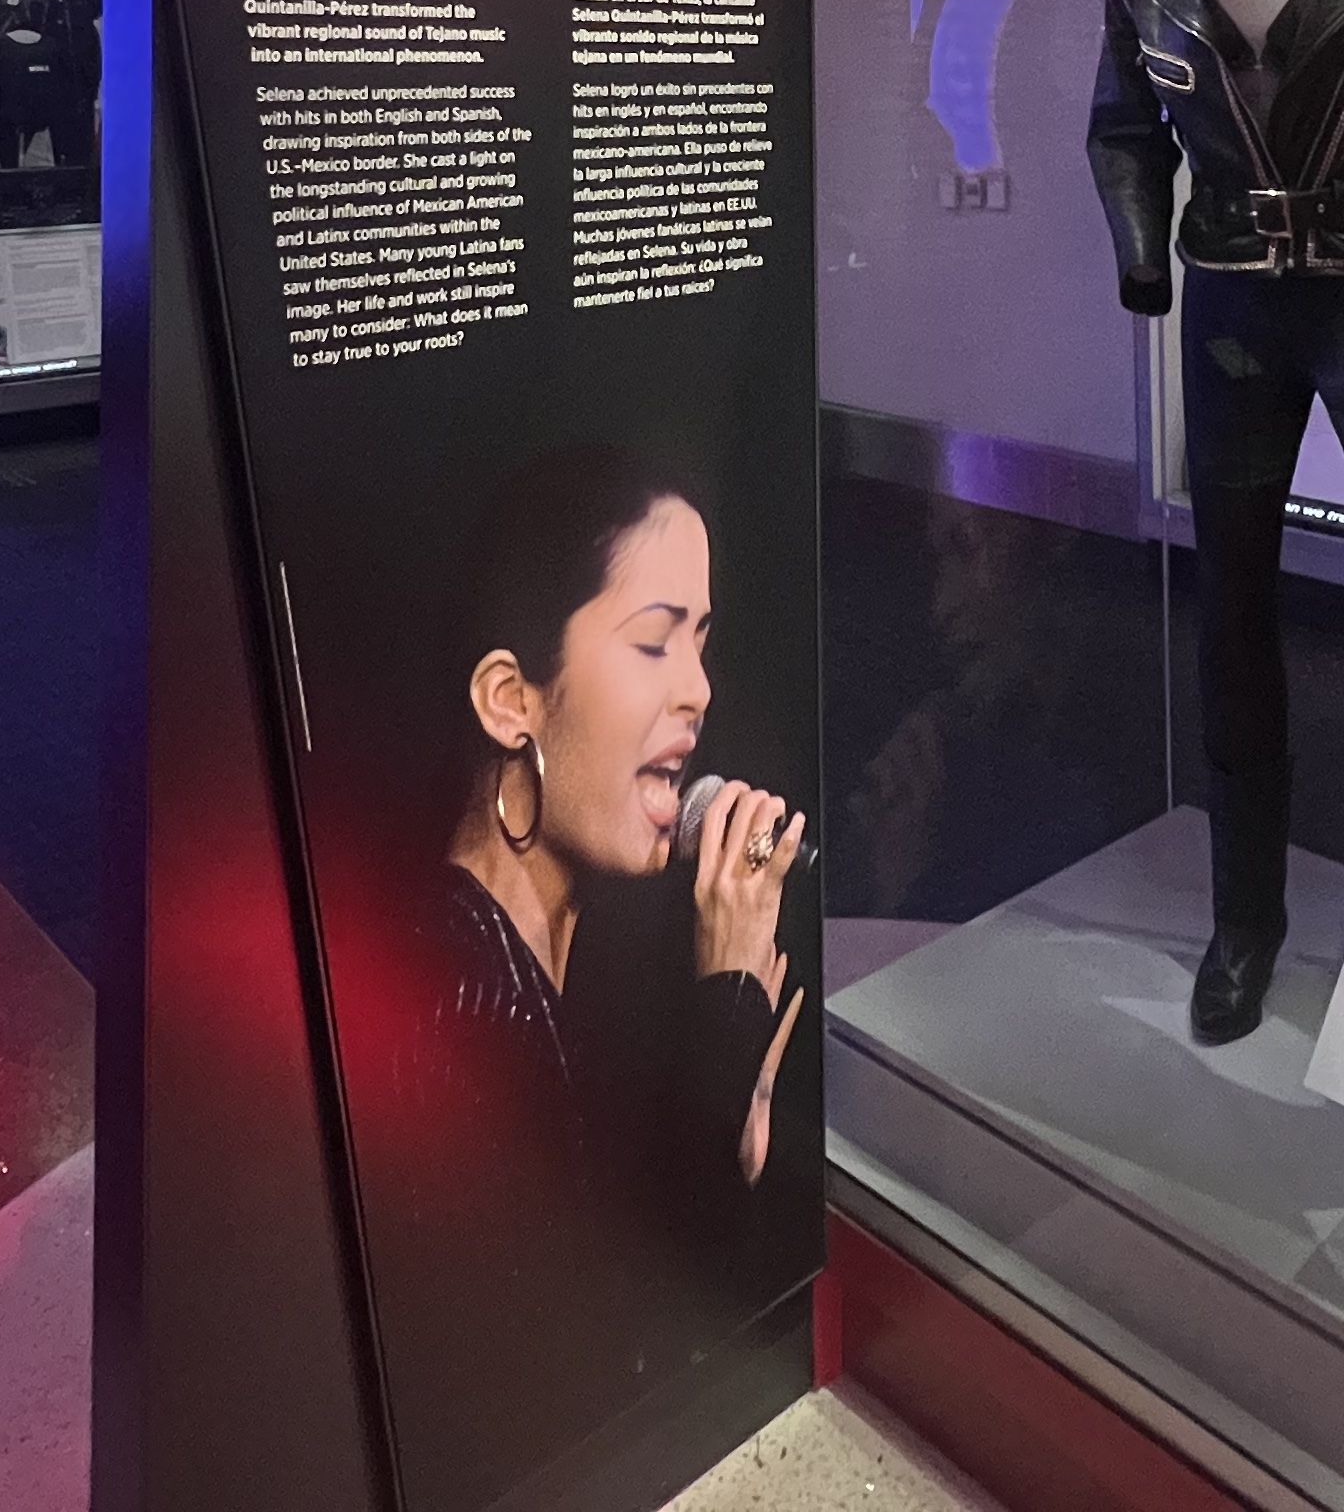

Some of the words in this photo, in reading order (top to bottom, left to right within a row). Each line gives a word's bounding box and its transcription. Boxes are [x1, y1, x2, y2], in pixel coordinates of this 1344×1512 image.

[370, 2, 452, 18] transformed
[453, 3, 476, 18] the
[247, 22, 300, 38] vibrant
[303, 23, 362, 41] regional
[364, 24, 406, 40] sound
[408, 24, 423, 40] of
[425, 25, 467, 42] Tejano
[468, 26, 505, 41] music
[250, 46, 280, 62] into
[283, 49, 302, 62] an
[304, 47, 394, 62] international
[395, 48, 485, 64] phenomenon.
[256, 86, 304, 102] Selena
[307, 85, 368, 101] achieved
[371, 84, 467, 101] unprecedented
[469, 86, 515, 98] success
[259, 110, 291, 126] with
[294, 109, 320, 125] hits
[324, 110, 337, 124] in
[340, 108, 372, 124] both
[374, 107, 422, 125] English
[424, 106, 449, 122] and
[451, 106, 502, 122] Spanish,
[262, 134, 320, 151] drawing
[324, 132, 394, 149] inspiration
[397, 130, 428, 145] from
[430, 129, 461, 144] both
[463, 128, 494, 143] sides
[496, 126, 510, 142] of
[511, 127, 532, 142] the
[266, 157, 350, 174] U.S.-Mexico
[352, 154, 401, 170] border.
[402, 152, 428, 168] She
[430, 152, 456, 167] cast
[458, 153, 467, 166] a
[469, 150, 496, 167] light
[498, 151, 515, 164] on
[269, 183, 294, 199] the
[297, 178, 386, 198] longstanding
[388, 175, 437, 192] cultural
[439, 173, 464, 189] and
[466, 171, 516, 190] growing
[272, 204, 328, 225] political
[332, 202, 393, 218] influence
[395, 198, 410, 214] of
[412, 197, 464, 213] Mexican
[466, 194, 523, 209] American
[276, 230, 304, 247] and
[307, 228, 349, 245] Latinx
[352, 222, 436, 241] communities
[439, 218, 478, 234] within
[480, 216, 500, 231] the
[279, 252, 326, 271] United
[330, 250, 376, 266] States.
[378, 247, 414, 262] Many
[416, 244, 456, 261] young
[459, 239, 496, 255] Latina
[499, 236, 524, 251] fans
[282, 281, 311, 295] saw
[314, 272, 391, 292] themselves
[393, 264, 450, 283] reflected
[452, 264, 464, 278] in
[467, 259, 516, 276] Selena's
[292, 352, 308, 367] to
[311, 349, 340, 364] stay
[343, 345, 372, 360] true
[374, 342, 389, 356] to
[392, 338, 422, 357] your
[424, 330, 464, 349] roots?
